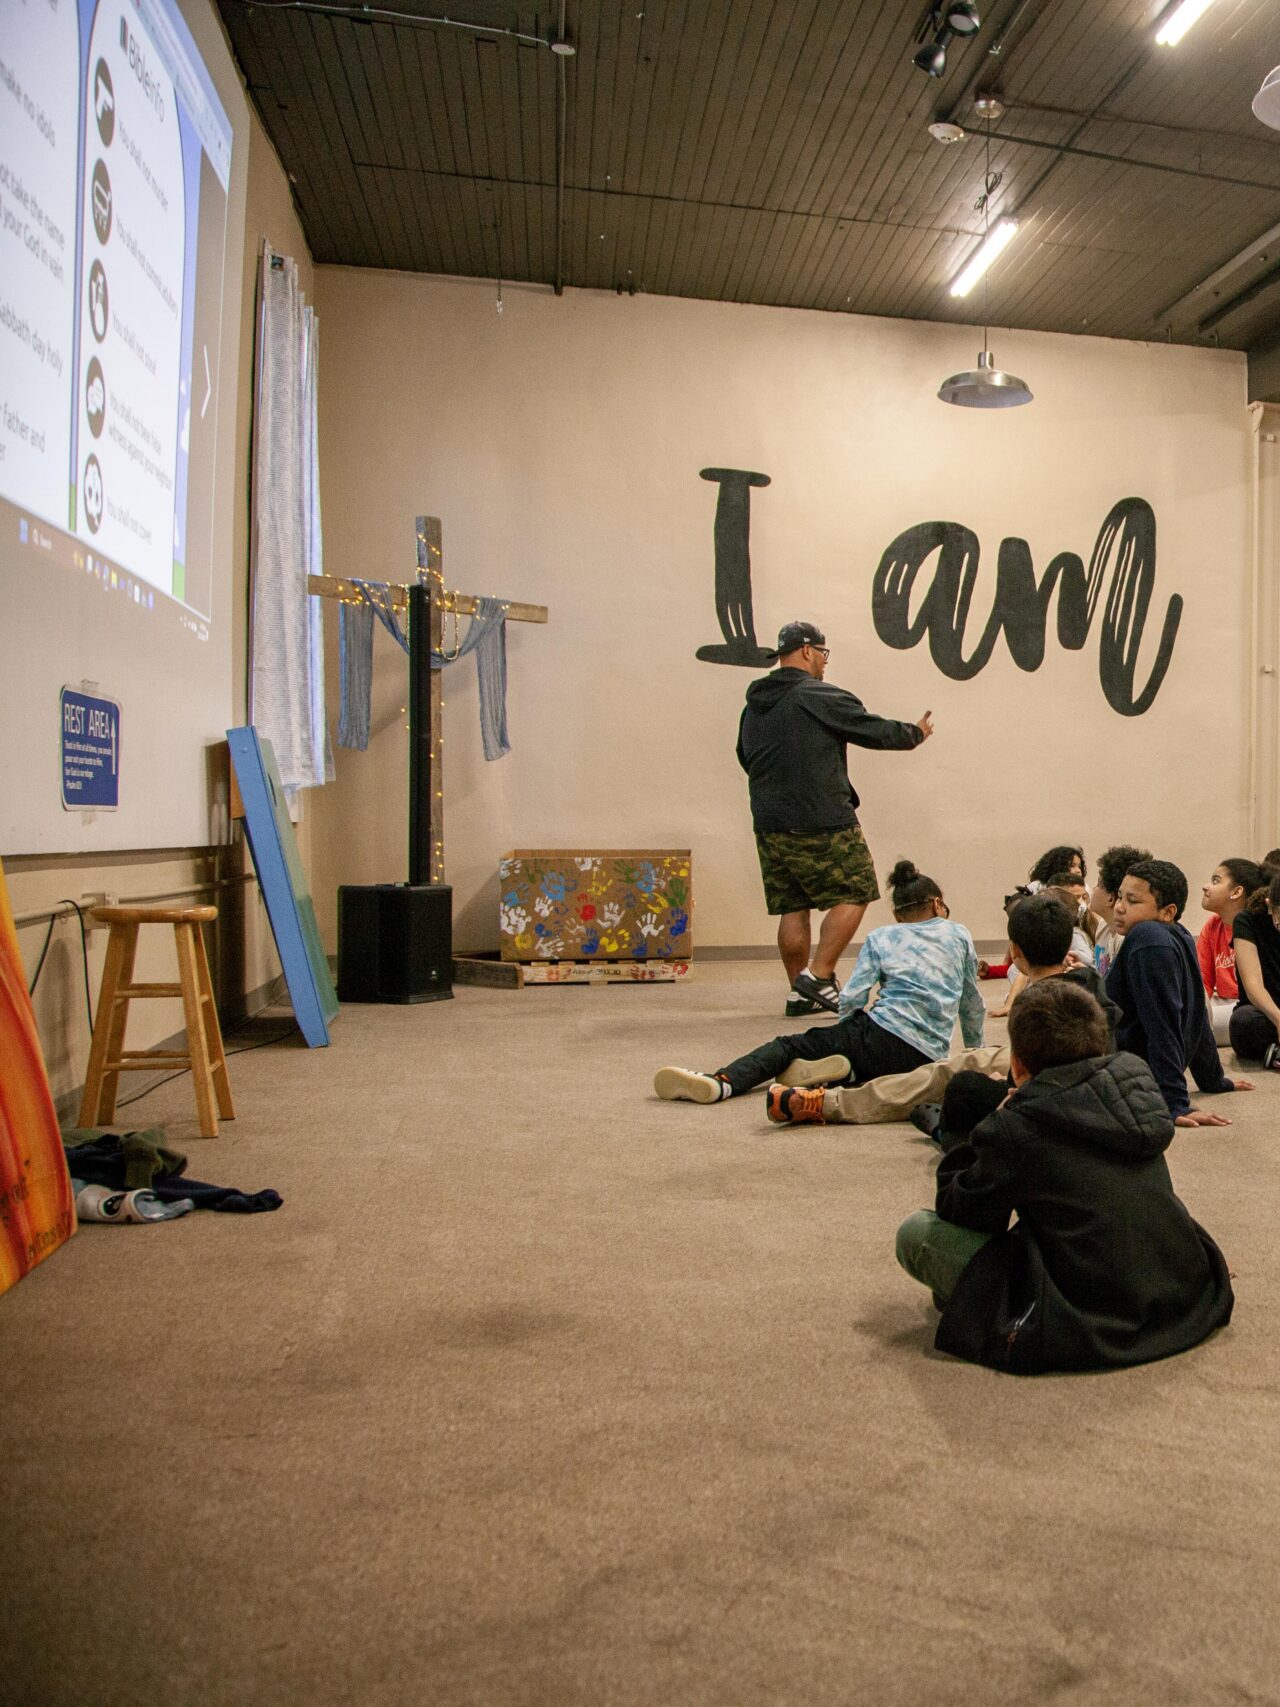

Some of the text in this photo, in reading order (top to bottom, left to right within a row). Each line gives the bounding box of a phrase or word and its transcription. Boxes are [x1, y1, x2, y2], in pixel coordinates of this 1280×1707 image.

[0, 299, 31, 345] abbath
[695, 466, 1184, 717] I am
[65, 703, 110, 739] REST AREA
